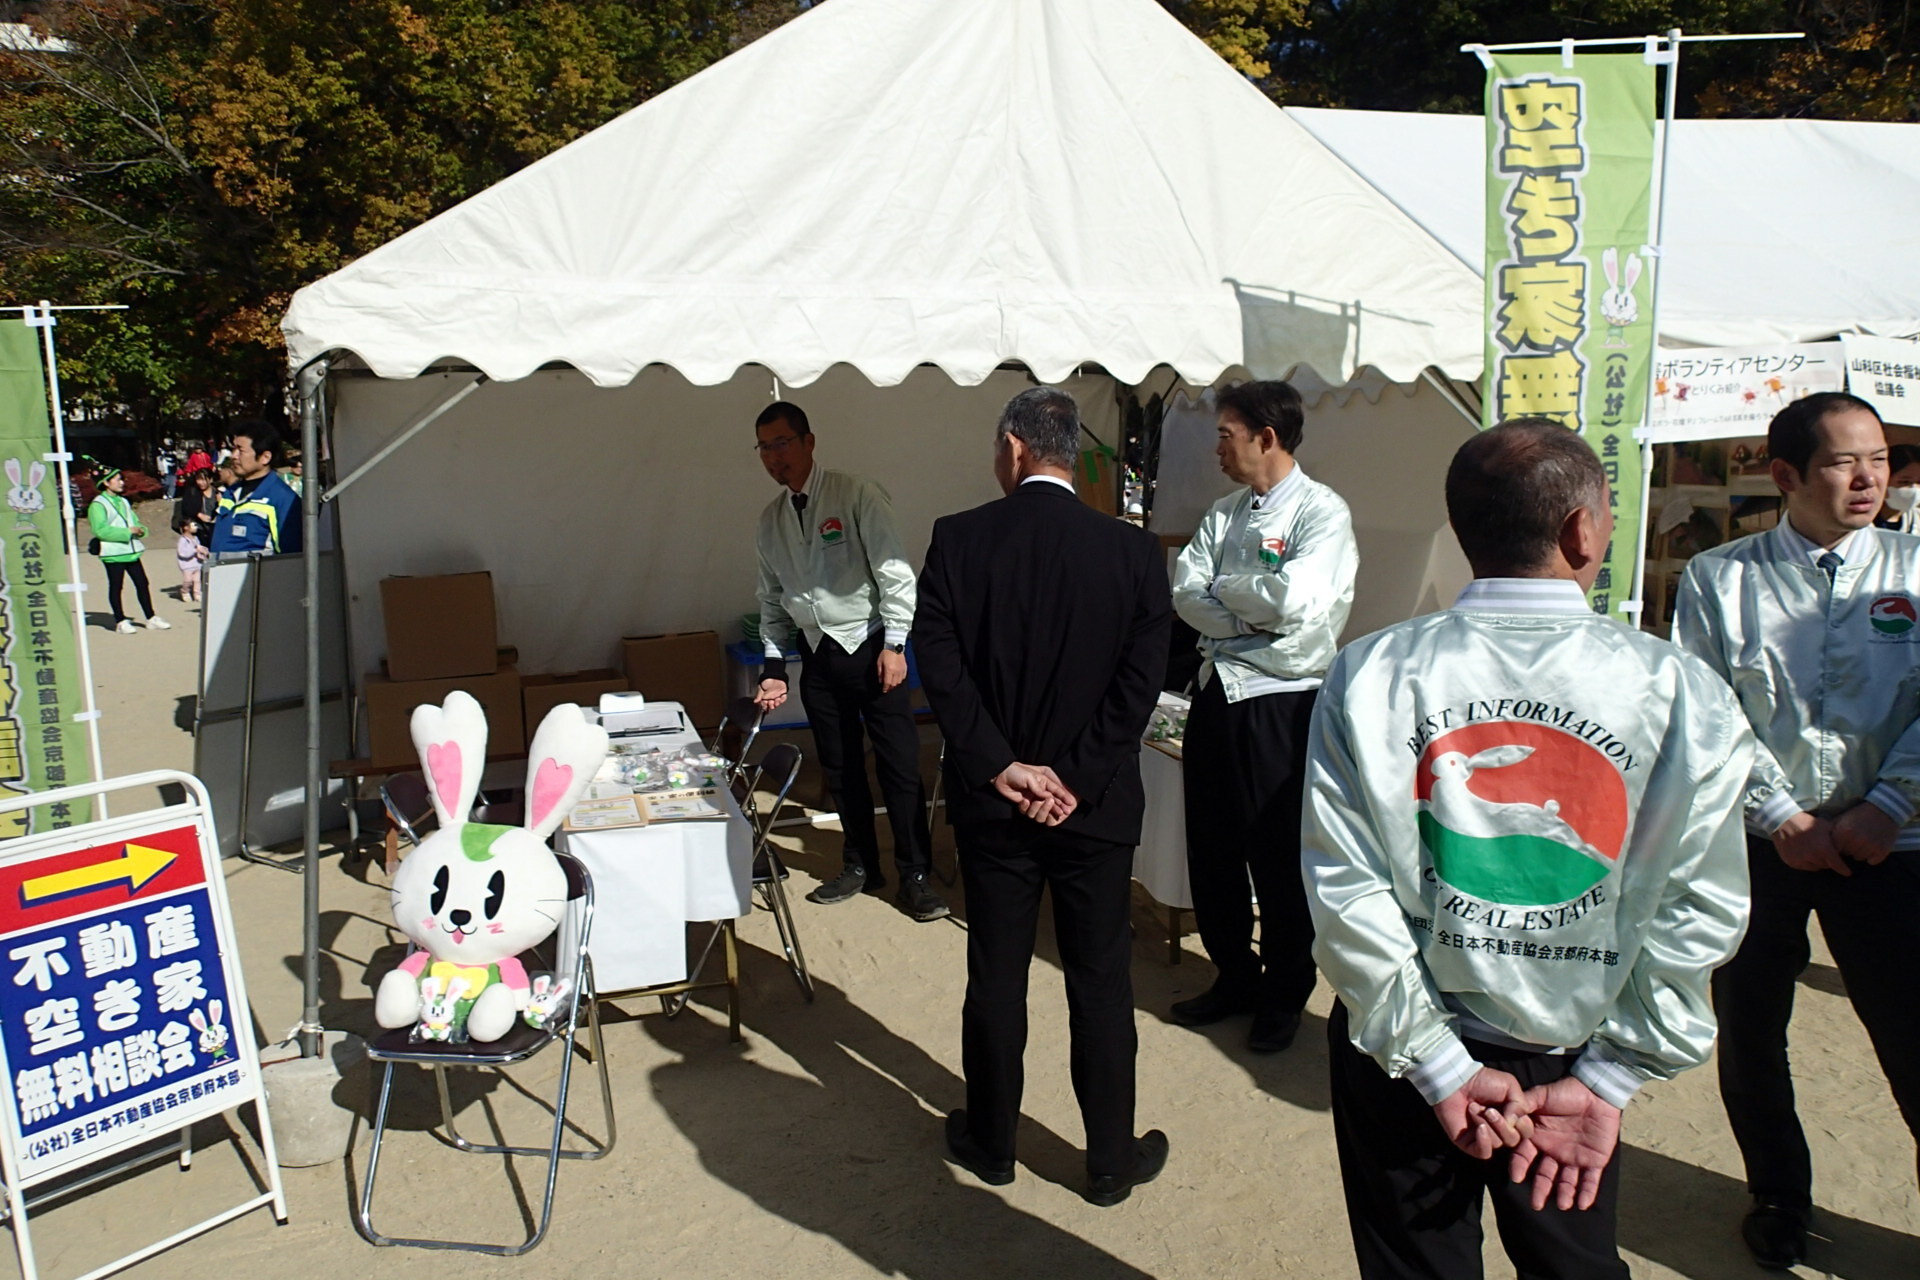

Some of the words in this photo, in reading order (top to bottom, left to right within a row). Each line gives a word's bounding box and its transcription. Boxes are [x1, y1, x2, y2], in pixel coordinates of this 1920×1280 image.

[1406, 708, 1451, 758] BEST
[1467, 698, 1639, 773] INFORMATION
[9, 904, 200, 992] 不動産
[1437, 929, 1620, 968] 全日本不動産協会京都府本部
[1443, 893, 1512, 930] REAL
[1521, 885, 1606, 931] ESTATE
[24, 959, 208, 1056] 空き家
[16, 1020, 197, 1126] 無料相談会
[28, 1068, 241, 1160] (公社)全日本不動産協会京都府本部
